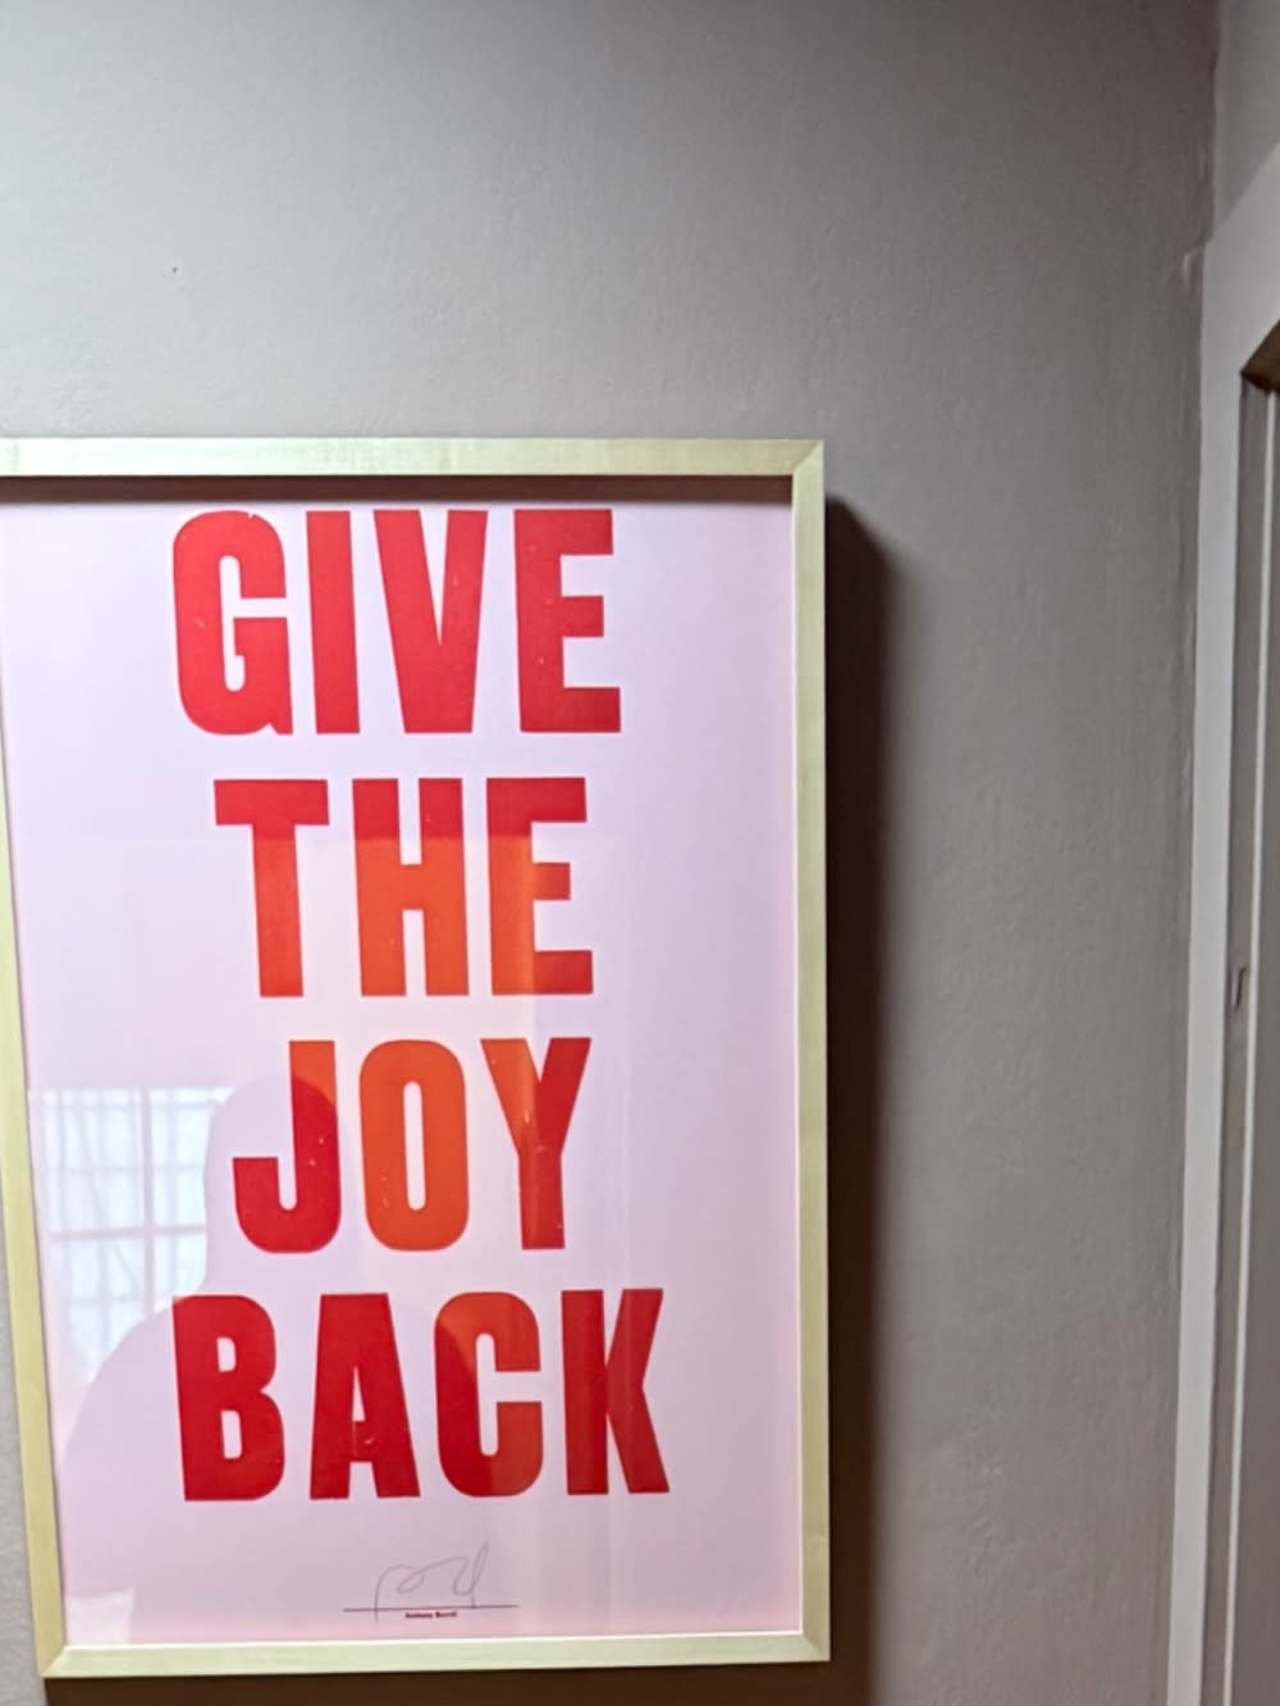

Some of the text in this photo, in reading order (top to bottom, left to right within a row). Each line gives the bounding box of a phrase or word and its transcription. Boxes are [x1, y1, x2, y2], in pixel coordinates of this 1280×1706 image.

[172, 509, 621, 736] GIVE
[214, 777, 594, 998] THE
[232, 1037, 591, 1254] JOY
[172, 1289, 670, 1501] BACK
